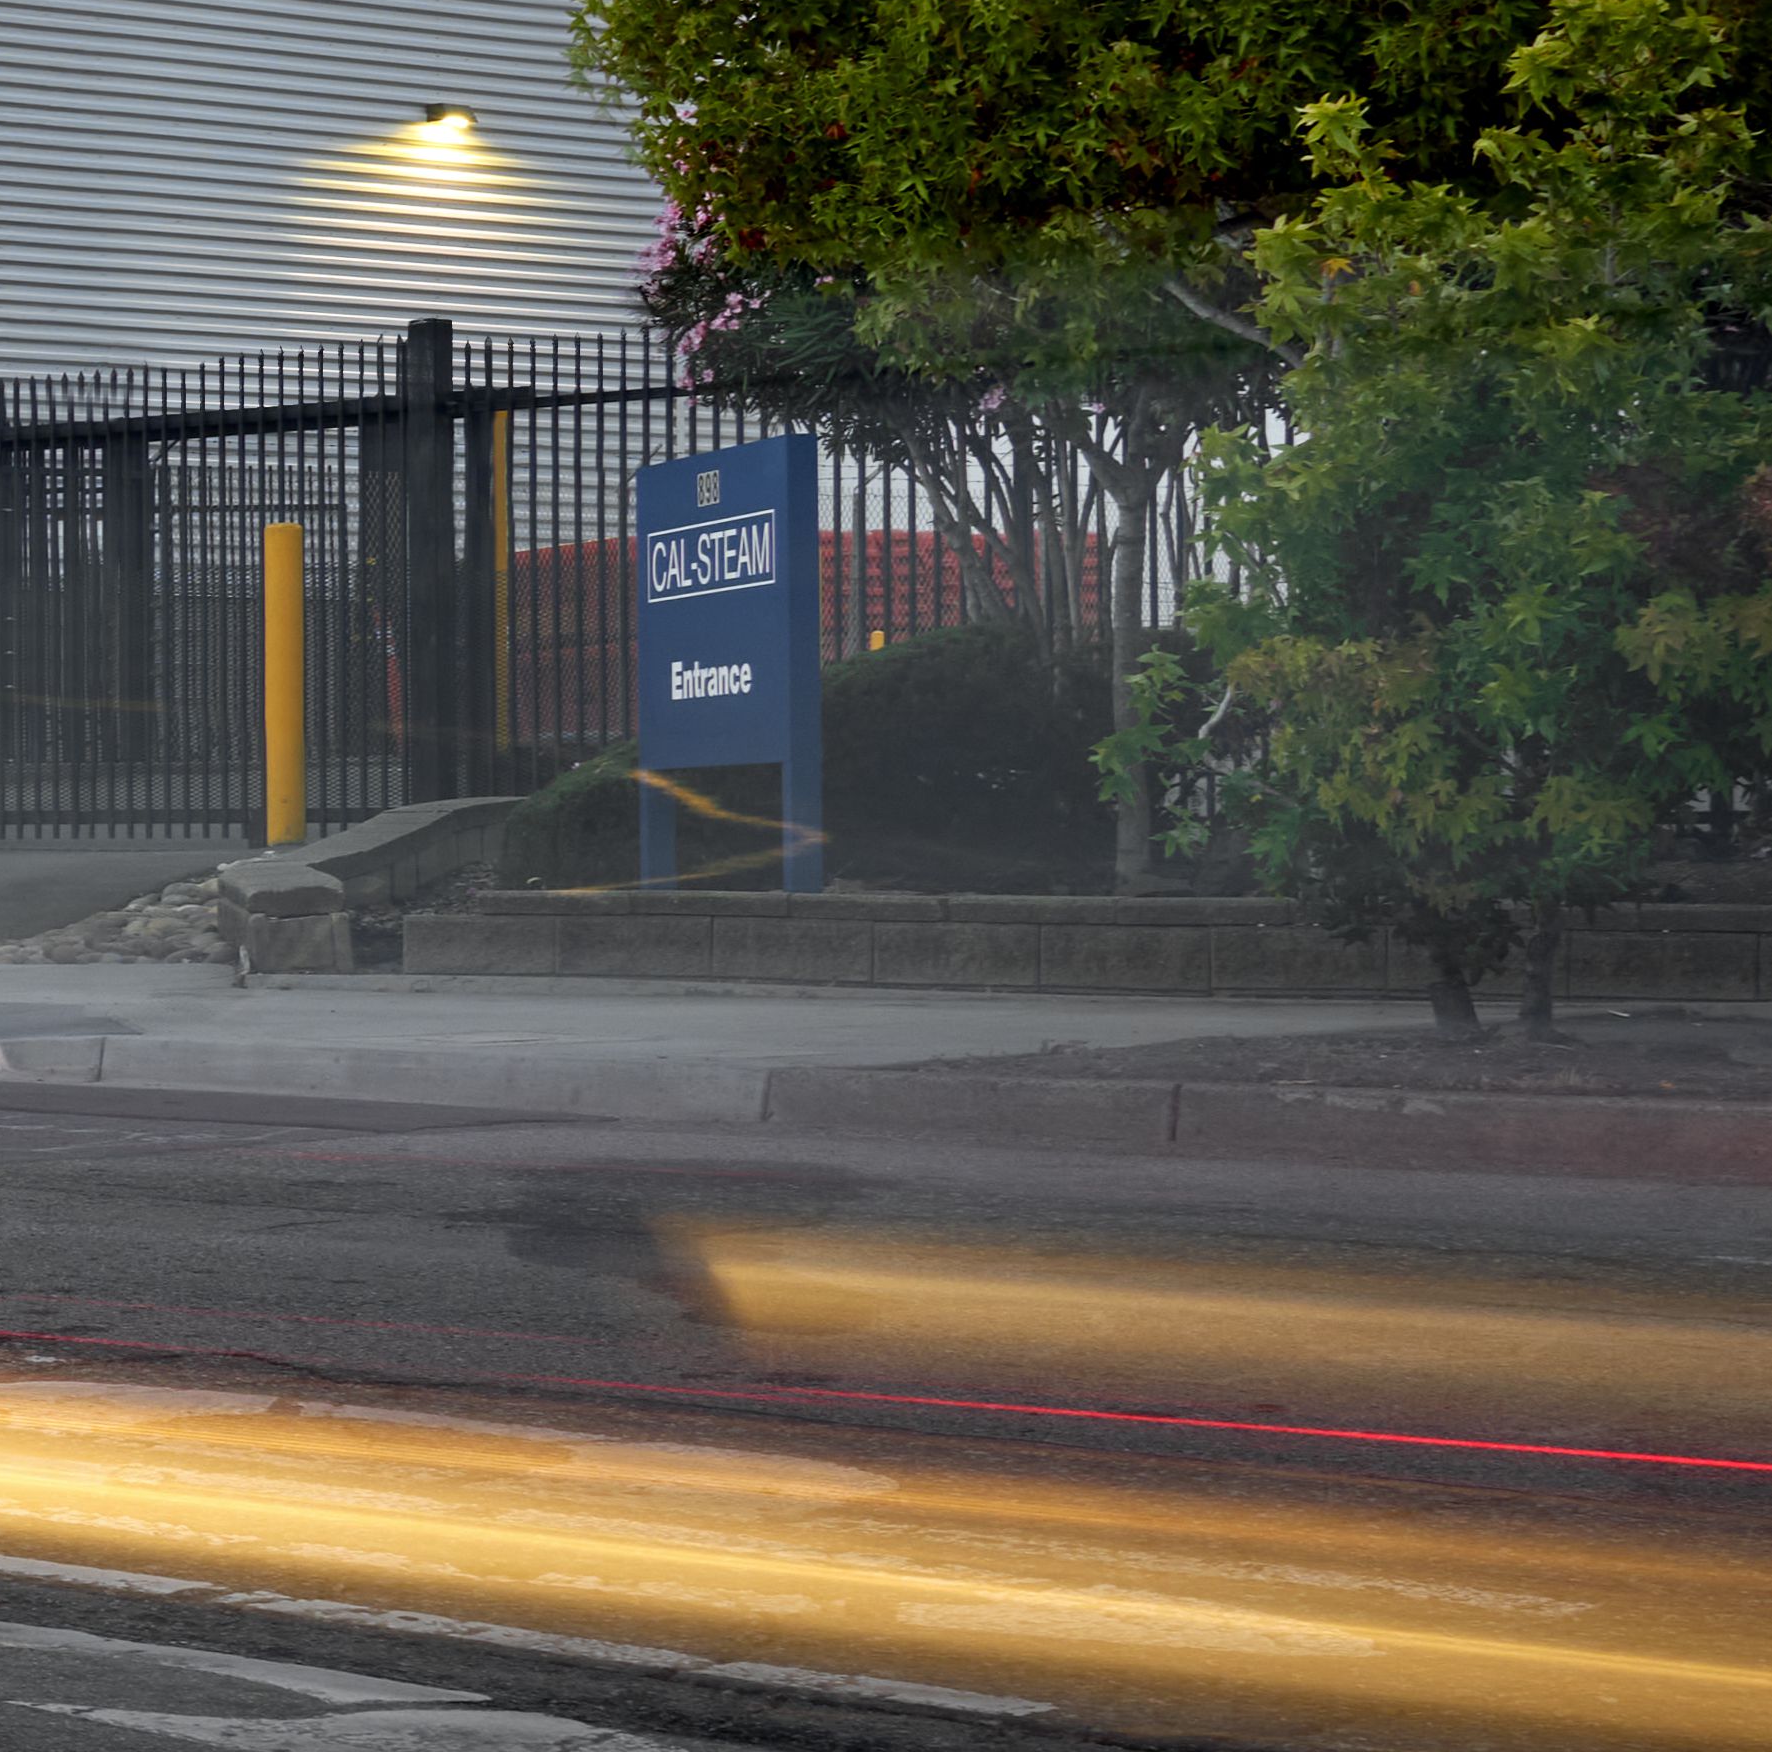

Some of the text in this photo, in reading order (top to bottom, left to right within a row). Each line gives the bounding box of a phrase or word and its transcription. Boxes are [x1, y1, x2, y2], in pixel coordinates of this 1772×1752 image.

[697, 471, 719, 505] 898
[651, 522, 770, 593] CAL-STEAM
[671, 660, 753, 700] Entrance
